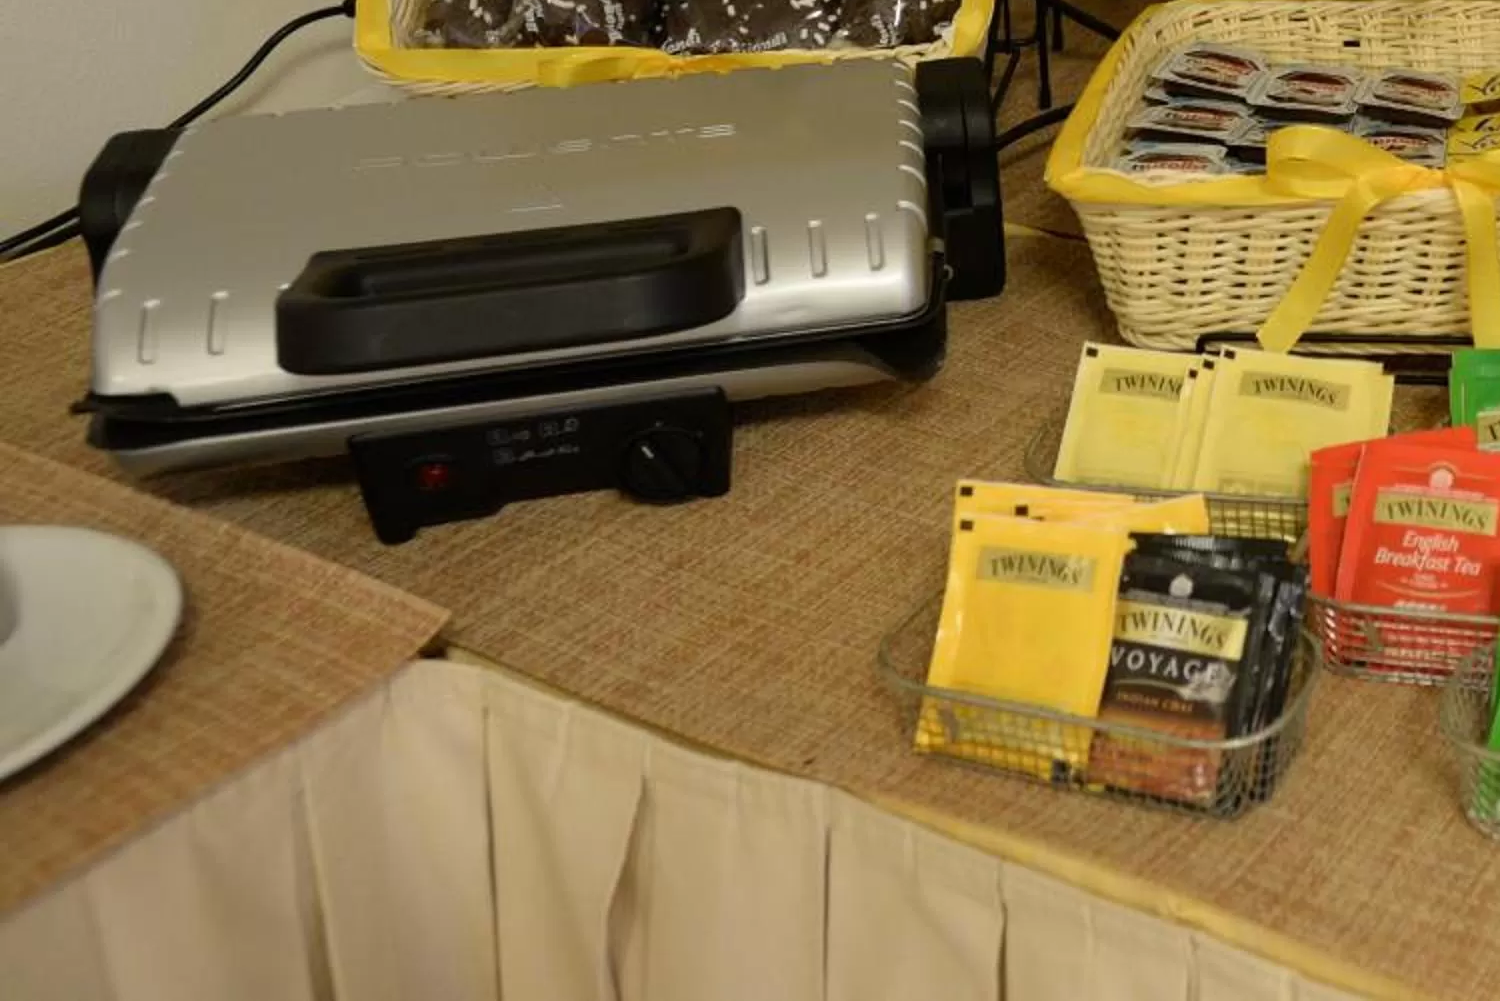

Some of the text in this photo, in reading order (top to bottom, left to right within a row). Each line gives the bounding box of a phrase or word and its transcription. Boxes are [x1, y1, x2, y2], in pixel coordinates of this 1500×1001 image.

[1114, 375, 1183, 395] TWINING
[1252, 377, 1339, 406] TWININGS
[1382, 498, 1489, 529] TWININGS
[1402, 529, 1460, 555] English
[989, 552, 1085, 586] TWININGS
[1374, 546, 1482, 577] Breakfast Tea
[1118, 609, 1227, 651] TWININGS
